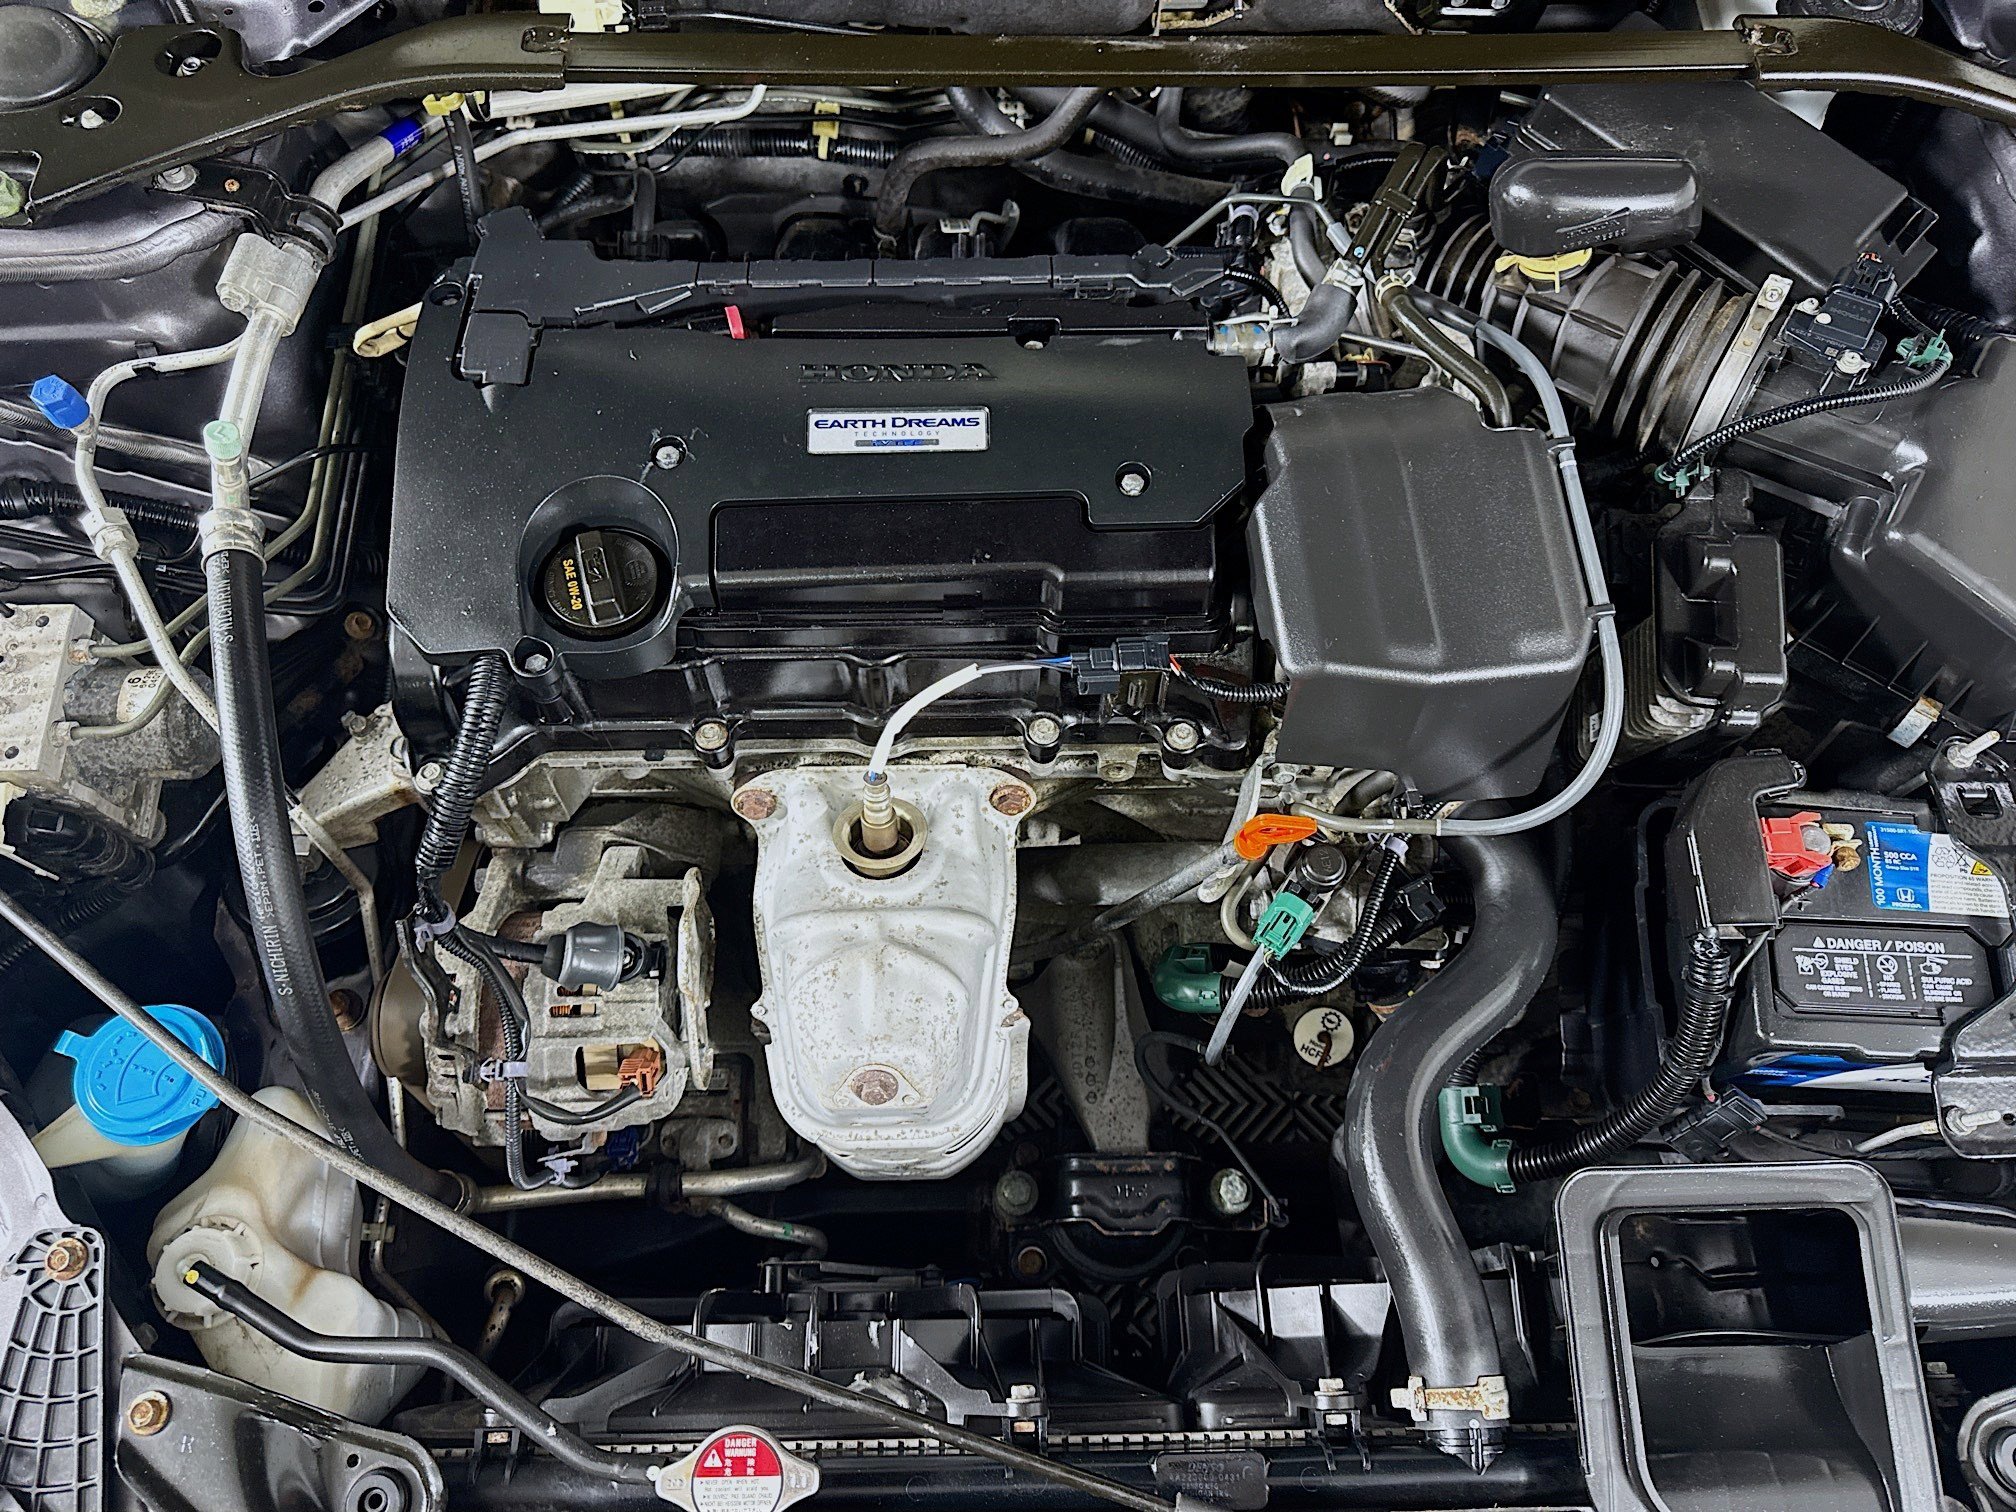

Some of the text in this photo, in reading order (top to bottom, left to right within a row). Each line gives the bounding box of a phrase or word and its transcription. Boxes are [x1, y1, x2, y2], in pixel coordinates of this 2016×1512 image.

[798, 363, 998, 383] HONDA
[814, 417, 980, 429] EARTH DREAMS
[563, 559, 583, 611] SAE 0W-20
[1884, 851, 1917, 860] 500 CCA
[1869, 847, 1886, 905] 100 MONTH
[1826, 938, 1881, 951] DANGER
[1895, 941, 1945, 953] POISON
[724, 1438, 757, 1448] DANGER
